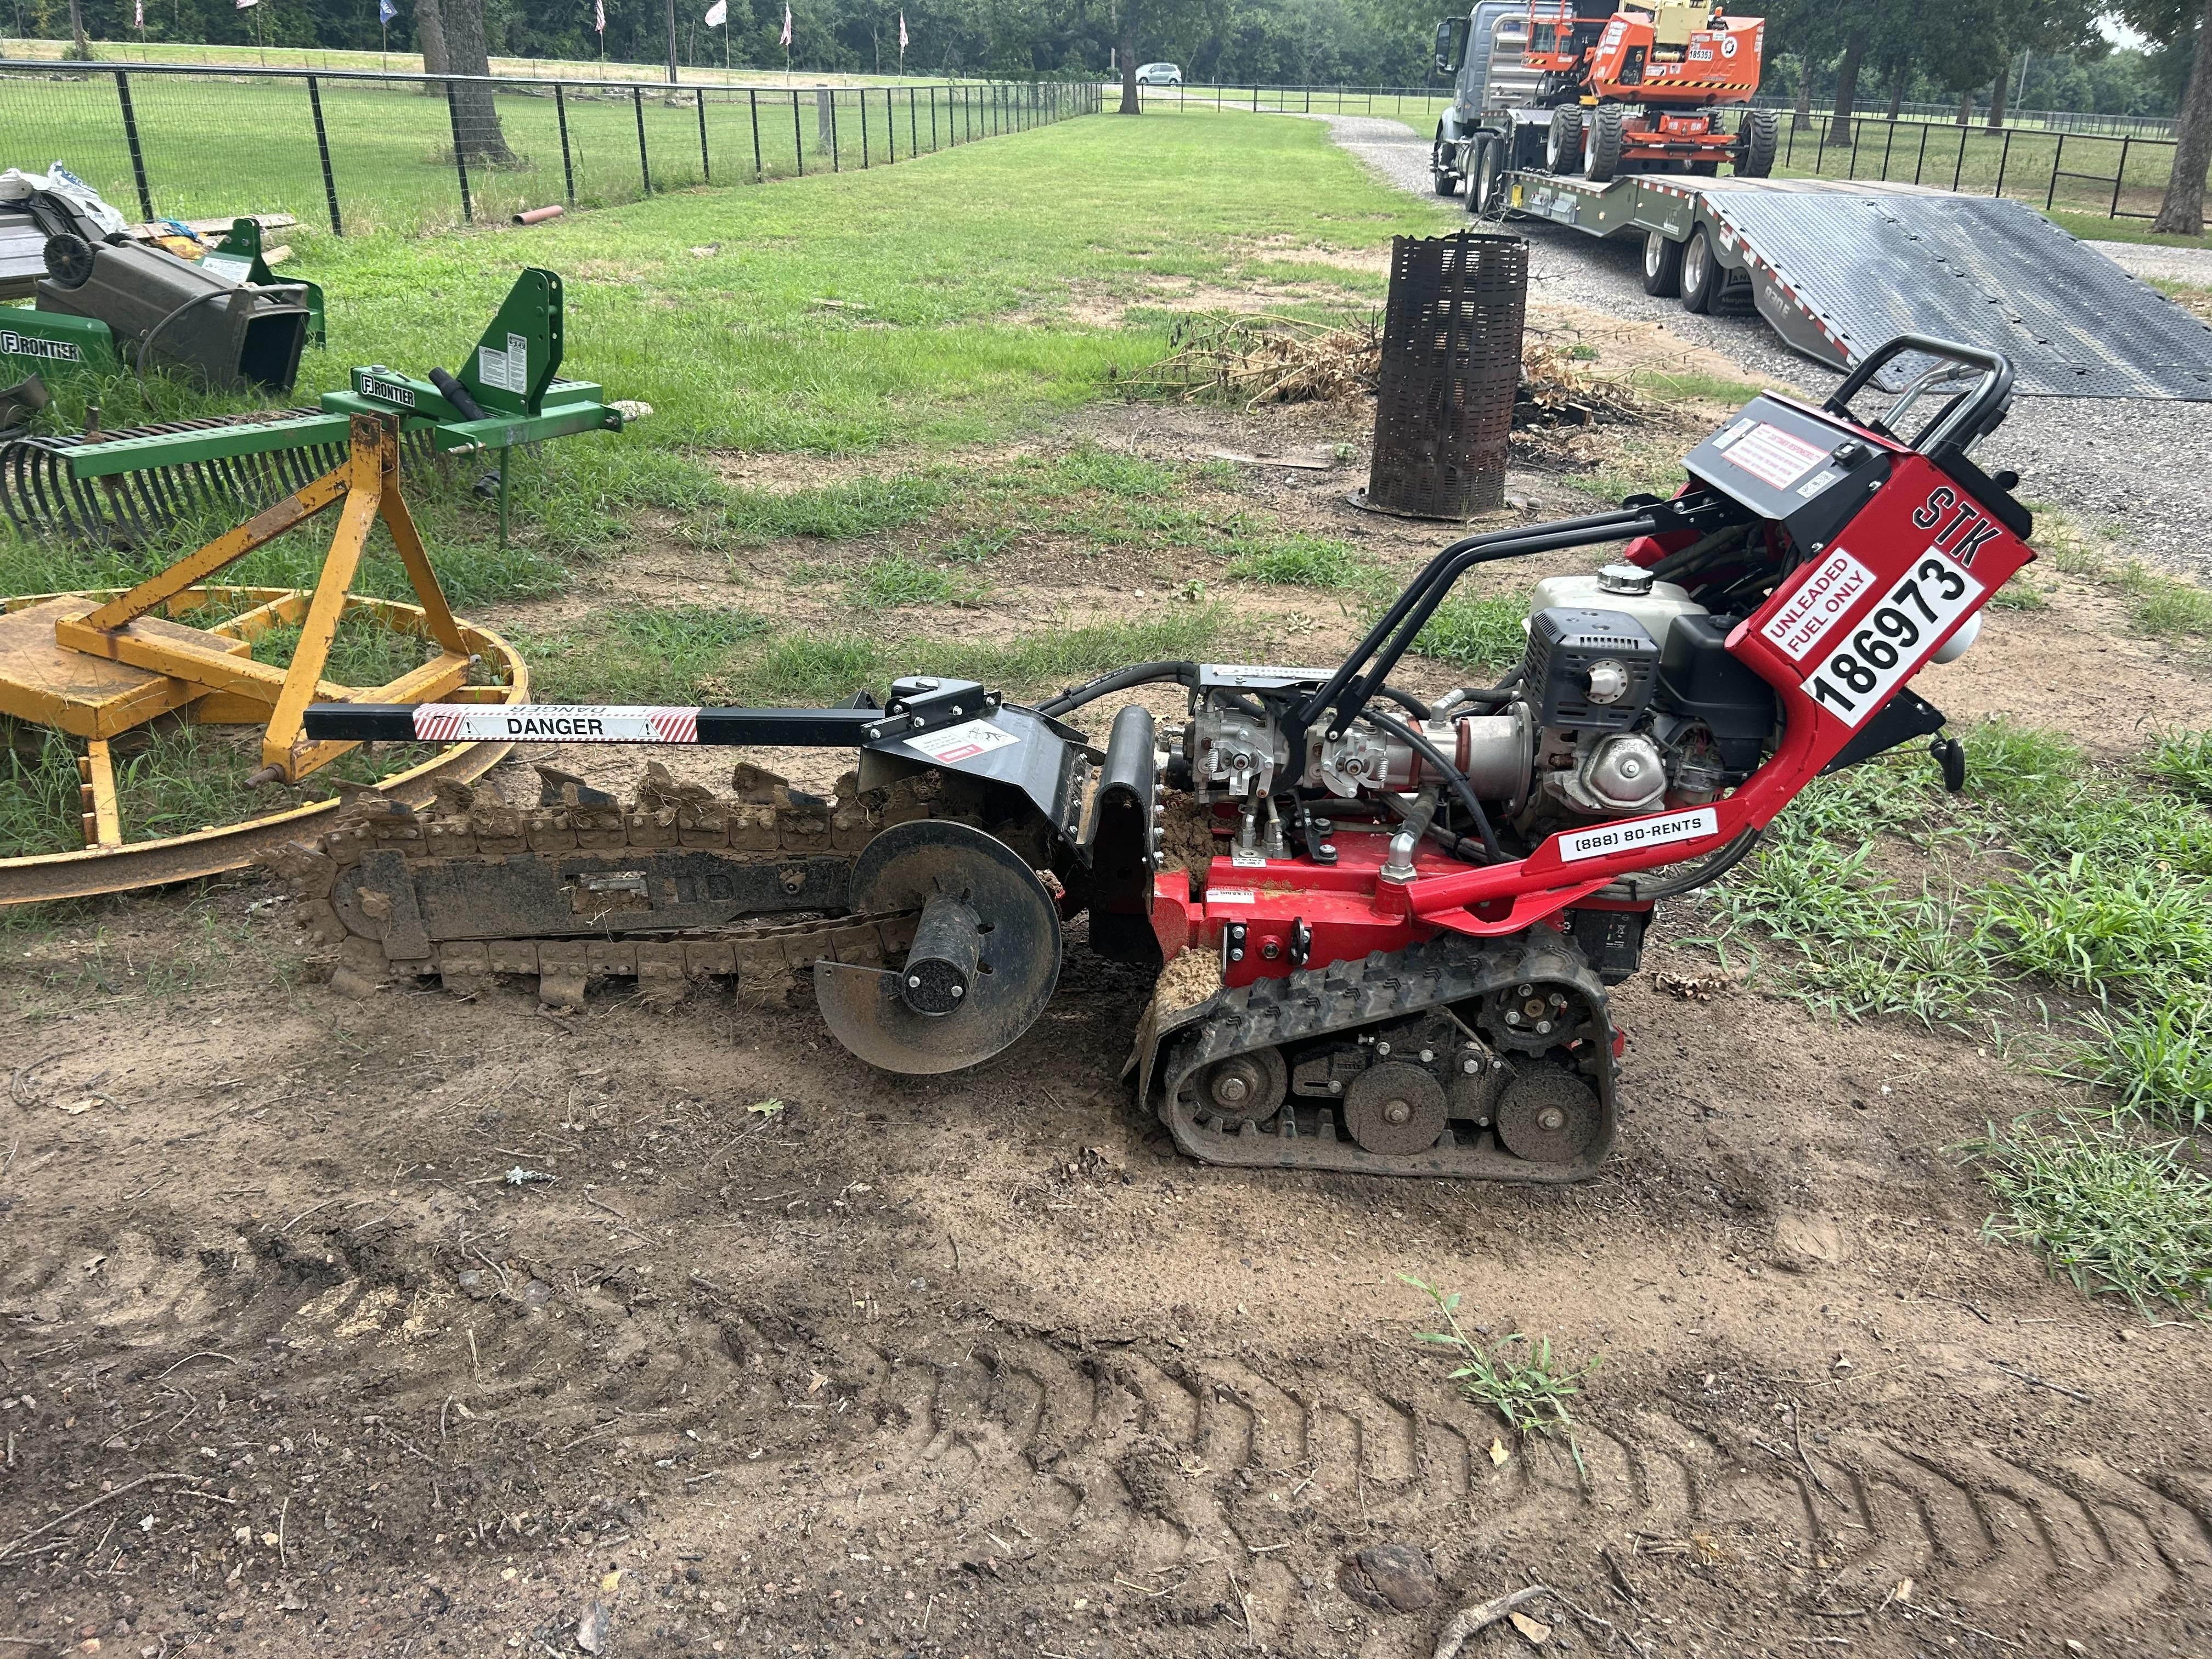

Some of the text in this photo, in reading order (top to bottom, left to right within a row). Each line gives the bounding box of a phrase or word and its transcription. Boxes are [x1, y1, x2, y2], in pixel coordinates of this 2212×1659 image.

[1690, 50, 1712, 59] 185353
[1699, 58, 1737, 76] JLG
[0, 330, 79, 362] FRONTIER
[360, 373, 415, 407] FRONTIER
[1912, 487, 2002, 568] STK
[1770, 558, 1848, 638] UNLEADED
[1787, 570, 1864, 653] FUEL ONLY
[1813, 559, 1965, 712] 186973
[507, 718, 604, 735] DANGER
[1576, 818, 1701, 851] (888) 80-RENTS
